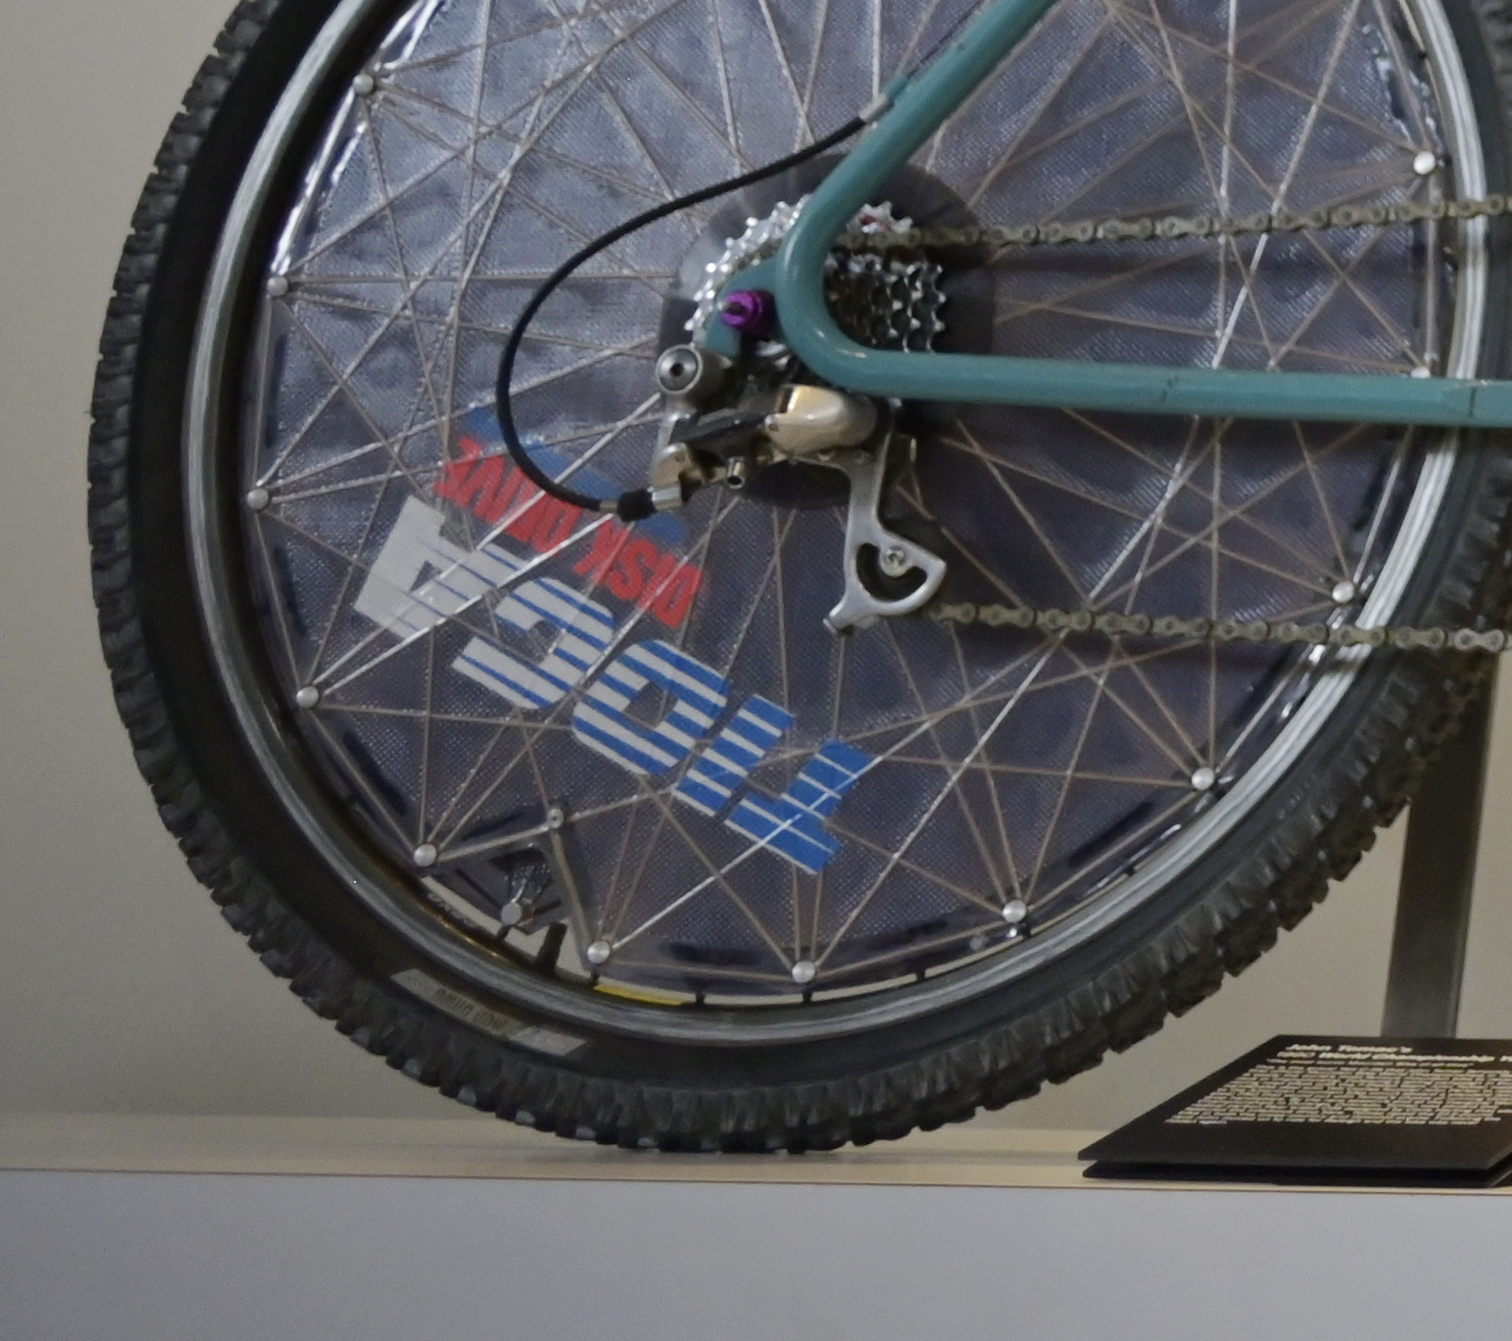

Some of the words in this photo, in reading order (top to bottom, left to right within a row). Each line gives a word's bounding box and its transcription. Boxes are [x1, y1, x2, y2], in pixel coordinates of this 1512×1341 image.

[434, 437, 583, 556] DRIVE
[574, 519, 706, 629] DISK
[354, 496, 873, 875] TIOGA
